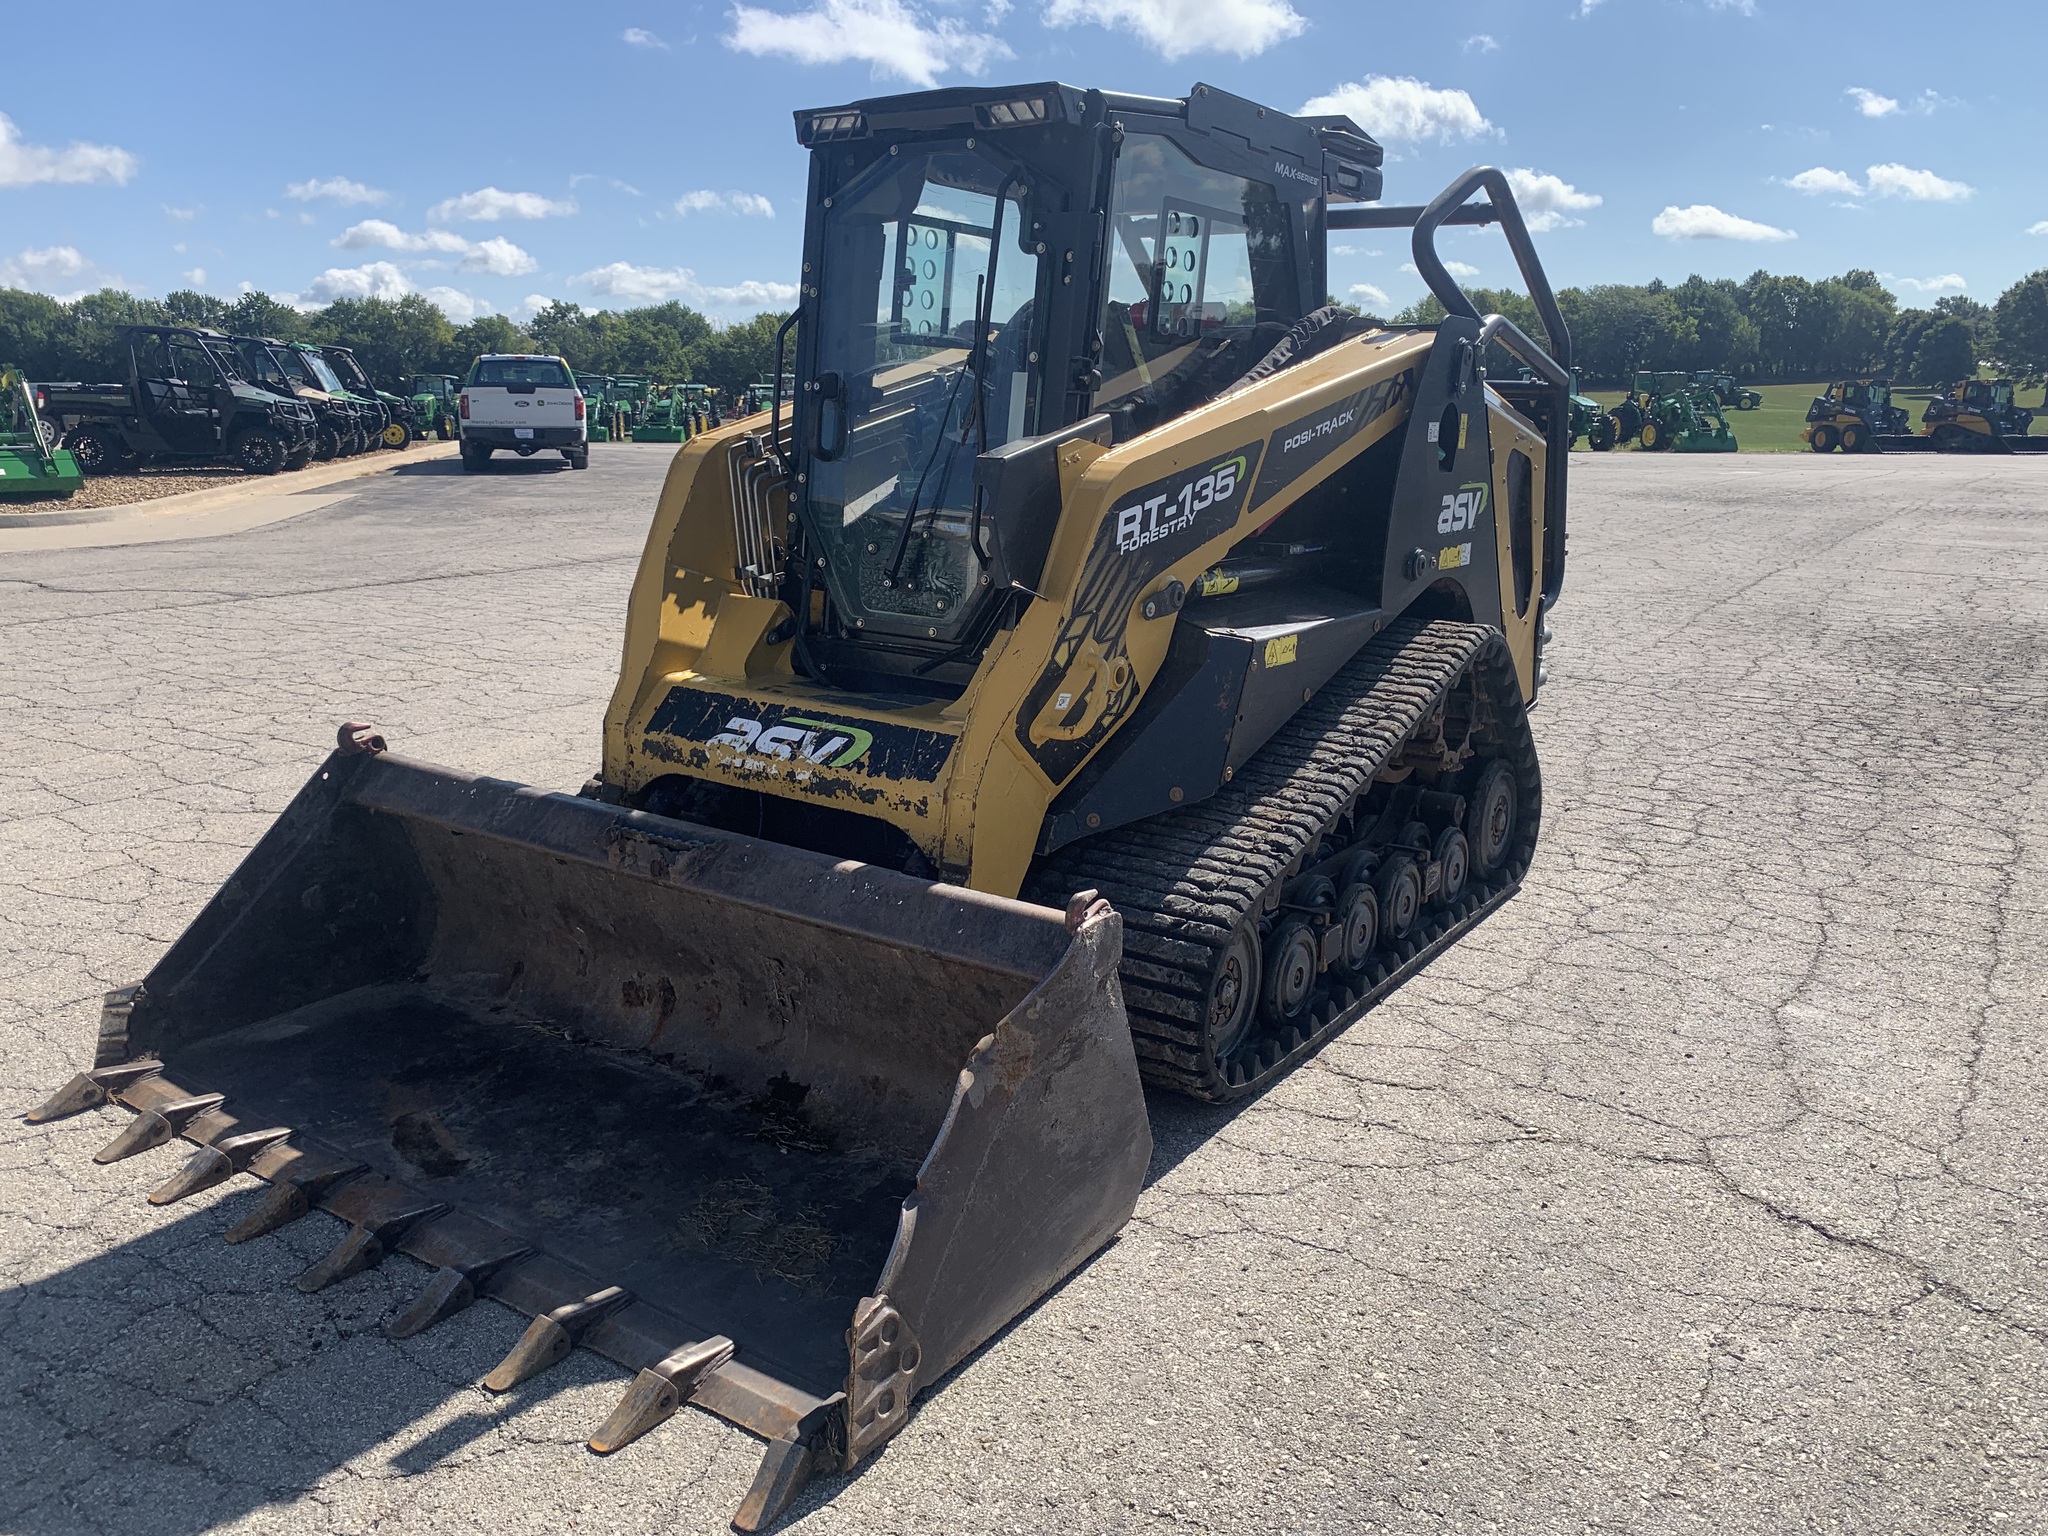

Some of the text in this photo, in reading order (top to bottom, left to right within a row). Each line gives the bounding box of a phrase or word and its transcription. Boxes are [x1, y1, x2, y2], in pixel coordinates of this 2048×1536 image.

[1274, 161, 1318, 186] MAX-SERIES
[1284, 408, 1354, 453] POSI-TRACK
[1116, 465, 1236, 545] RT-135
[1120, 511, 1197, 556] FORESTRY
